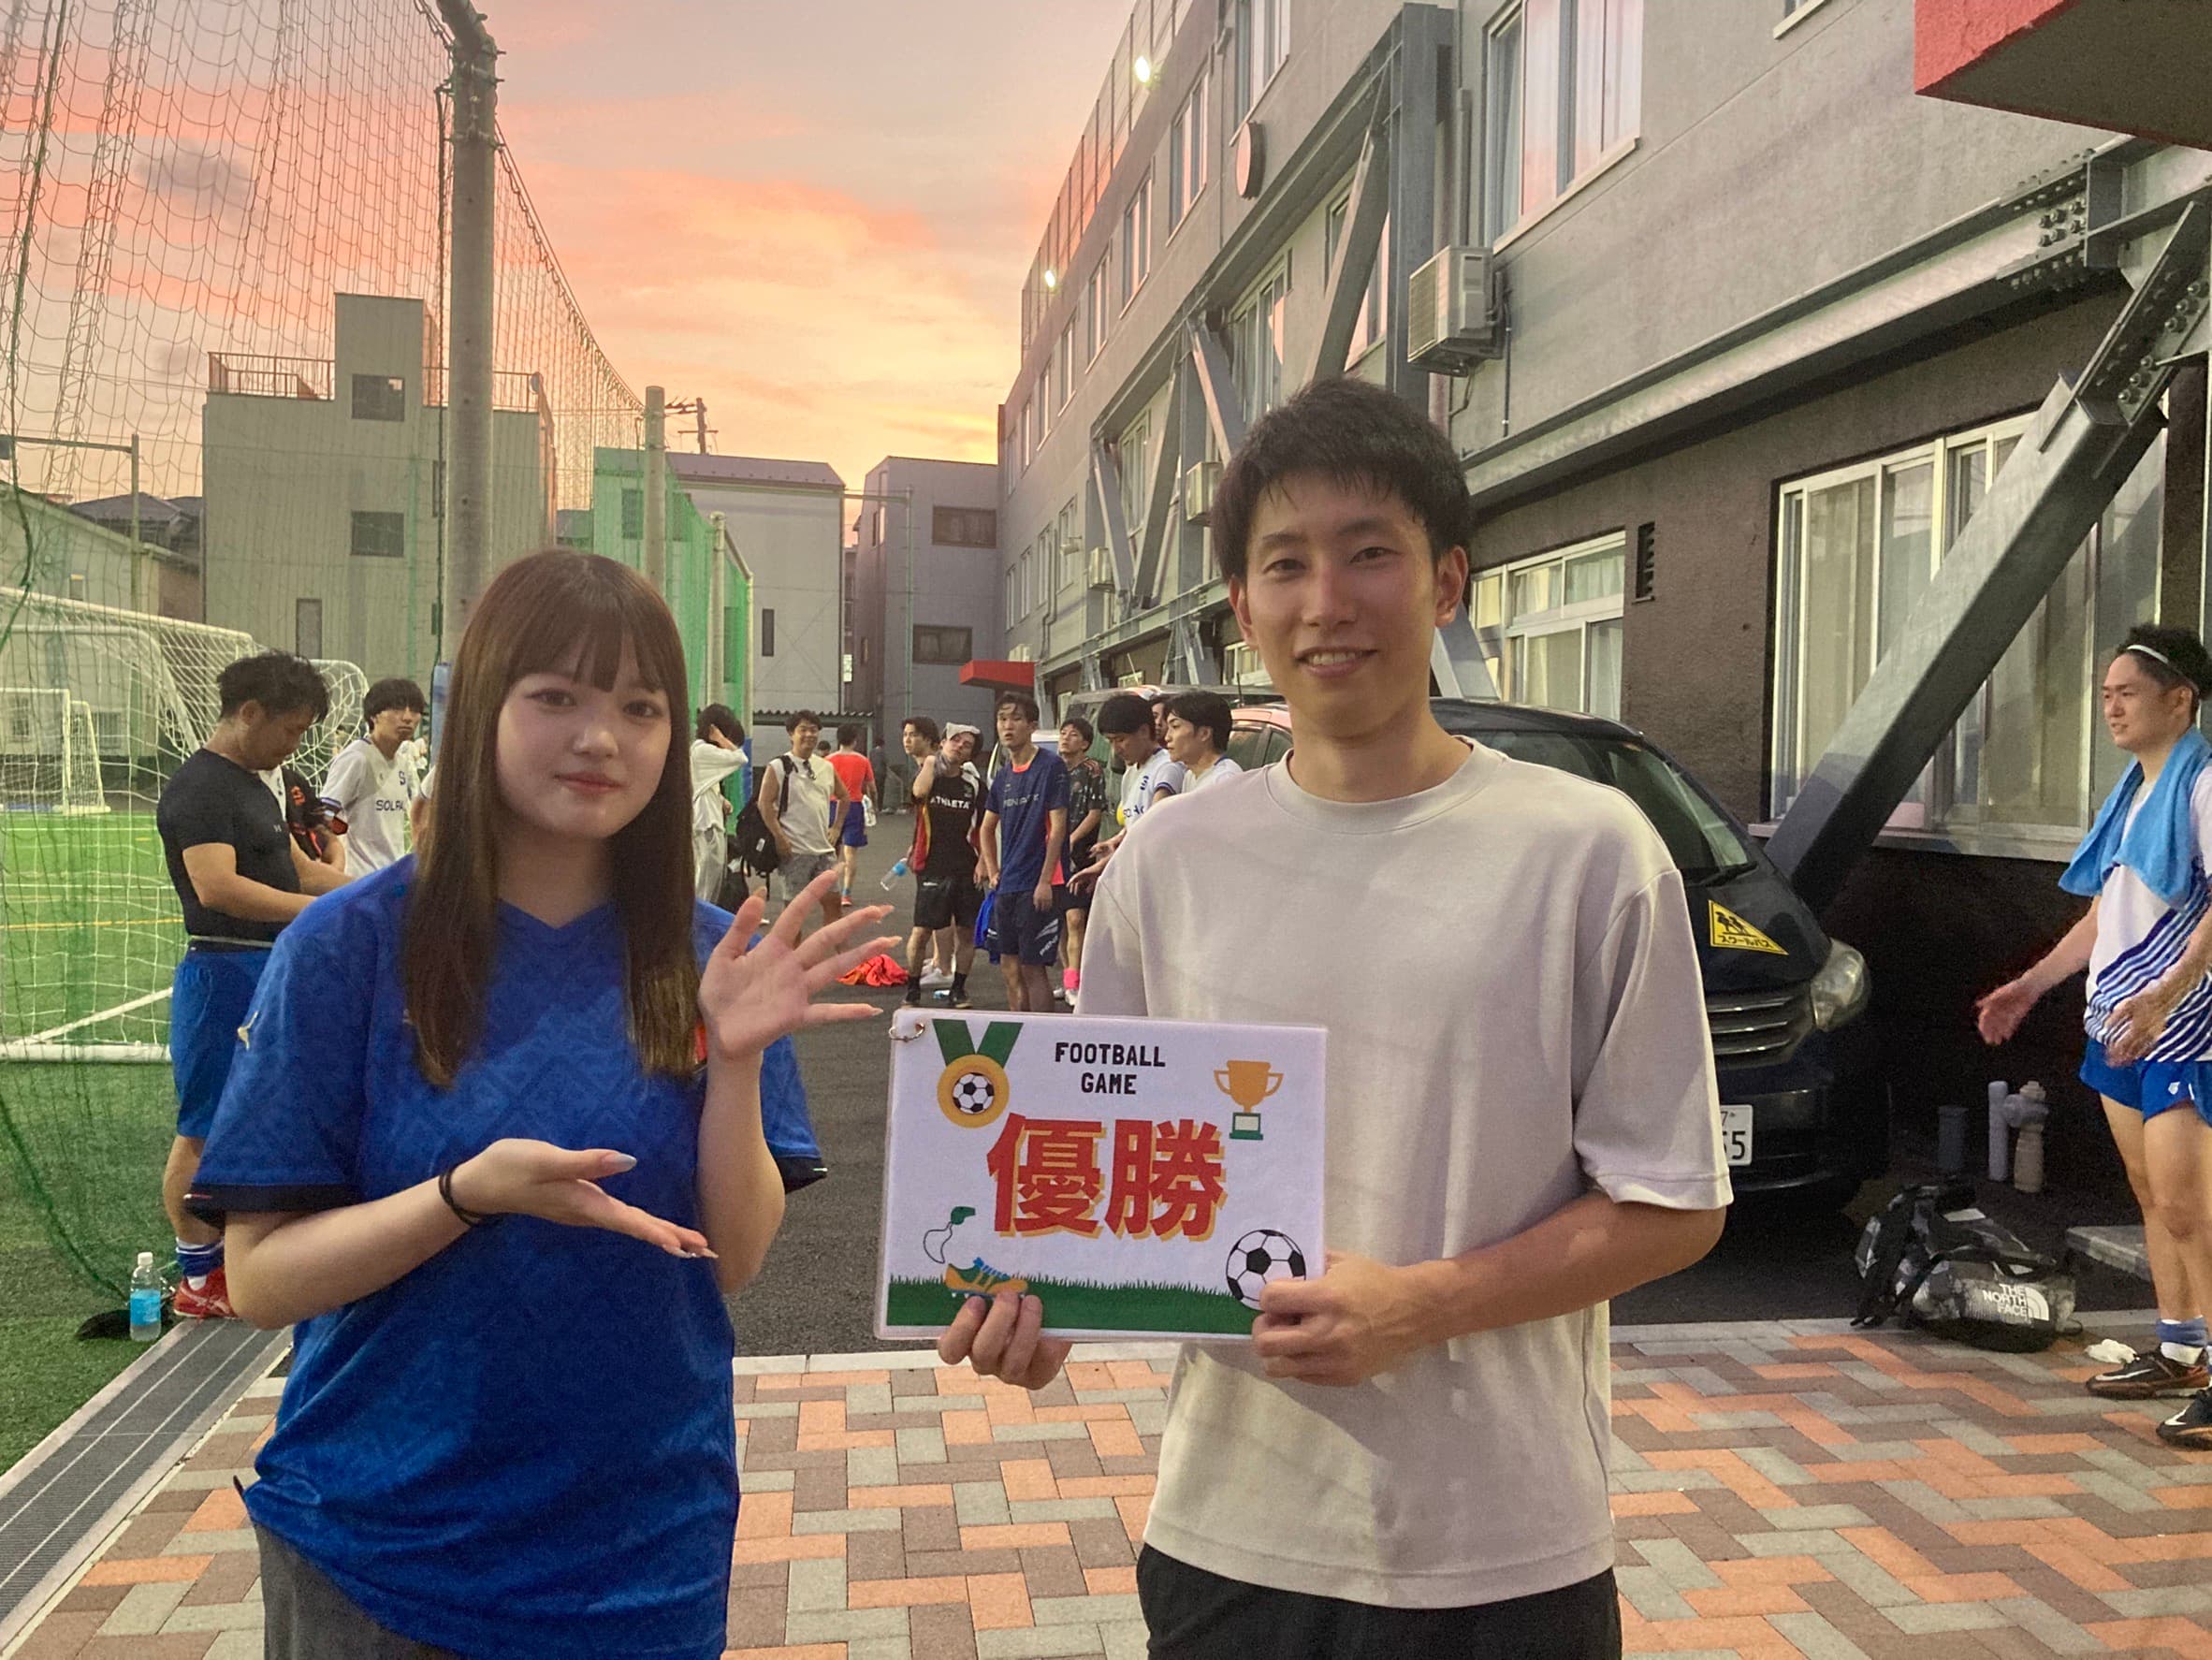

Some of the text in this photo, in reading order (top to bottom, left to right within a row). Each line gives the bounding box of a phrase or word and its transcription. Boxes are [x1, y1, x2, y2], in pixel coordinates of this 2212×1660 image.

[1055, 1041, 1166, 1068] FOOTBALL
[1081, 1071, 1137, 1095] GAME
[986, 1112, 1228, 1242] 優勝
[1982, 1289, 2027, 1307] NORTH
[1999, 1283, 2026, 1296] THE
[1997, 1304, 2027, 1318] FACE
